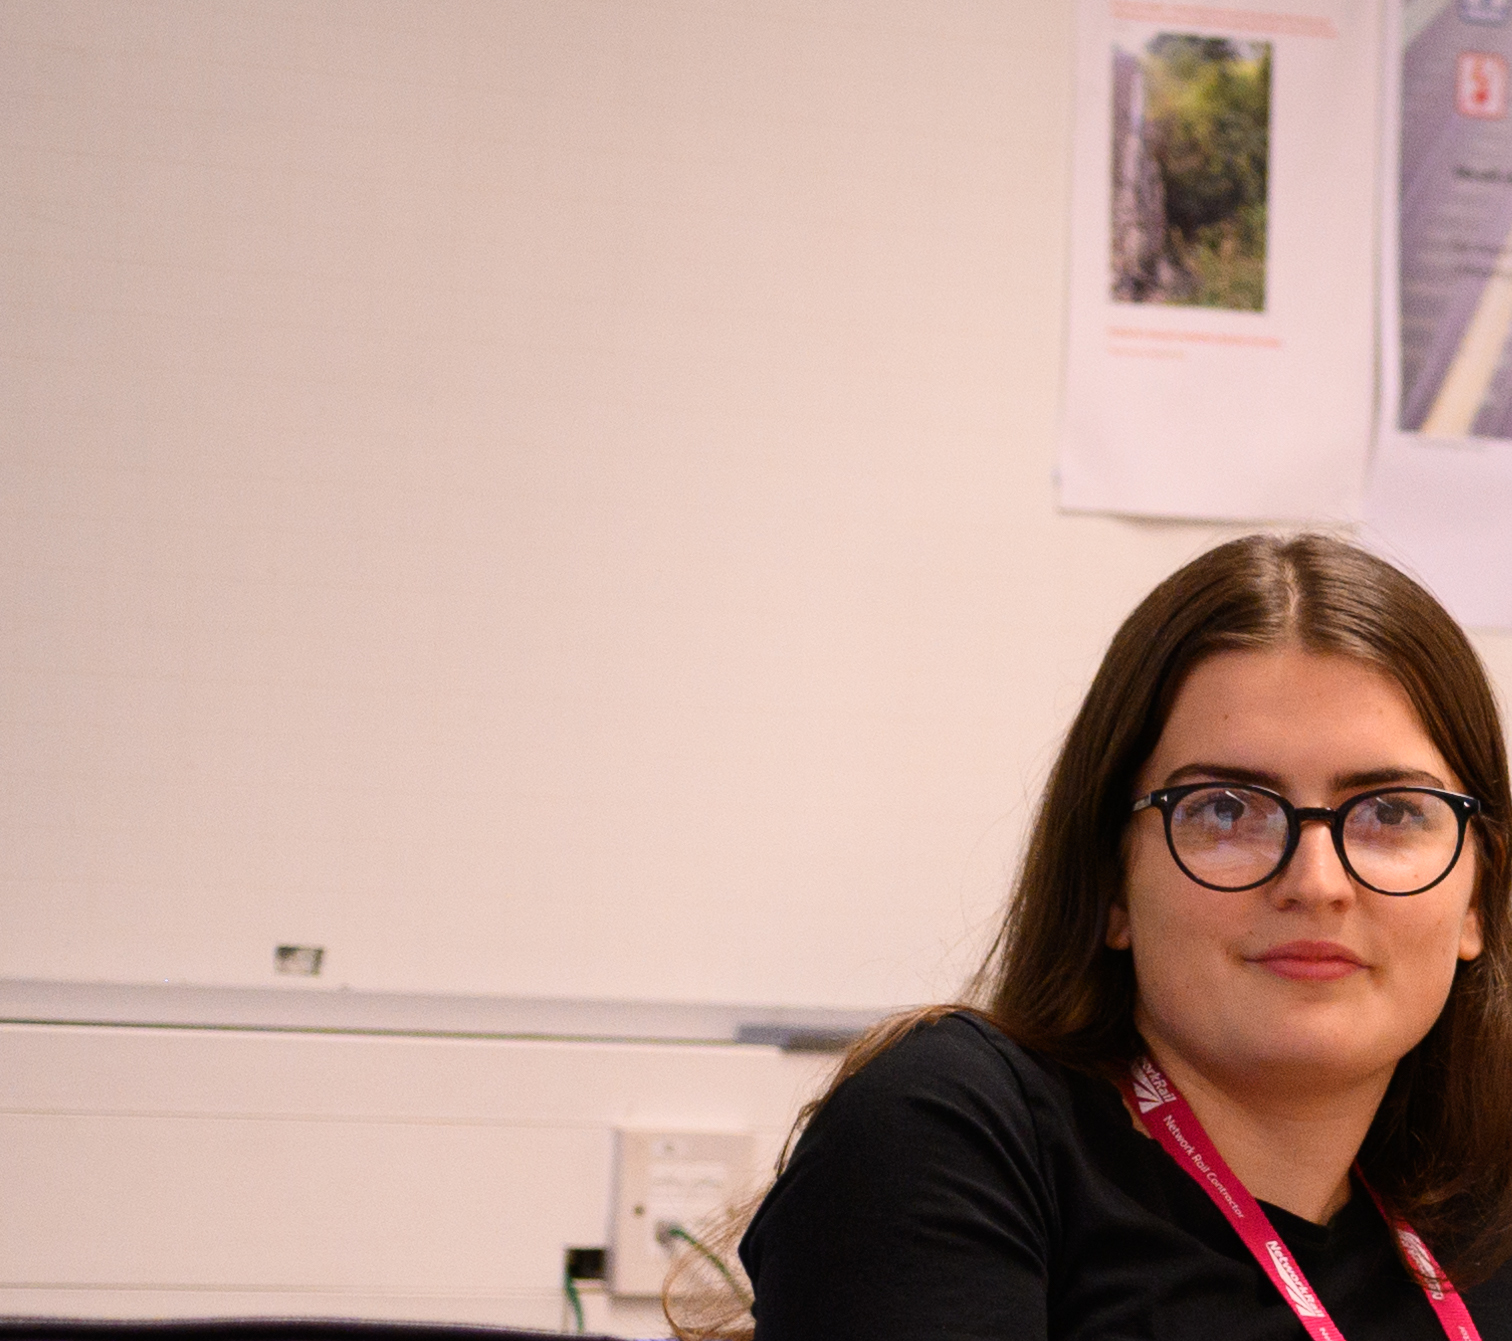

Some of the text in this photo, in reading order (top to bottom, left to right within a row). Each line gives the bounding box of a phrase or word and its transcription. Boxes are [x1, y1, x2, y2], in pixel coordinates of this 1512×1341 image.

[1163, 1114, 1244, 1219] Network Rail Contractor
[1265, 1240, 1326, 1318] NetworkRail
